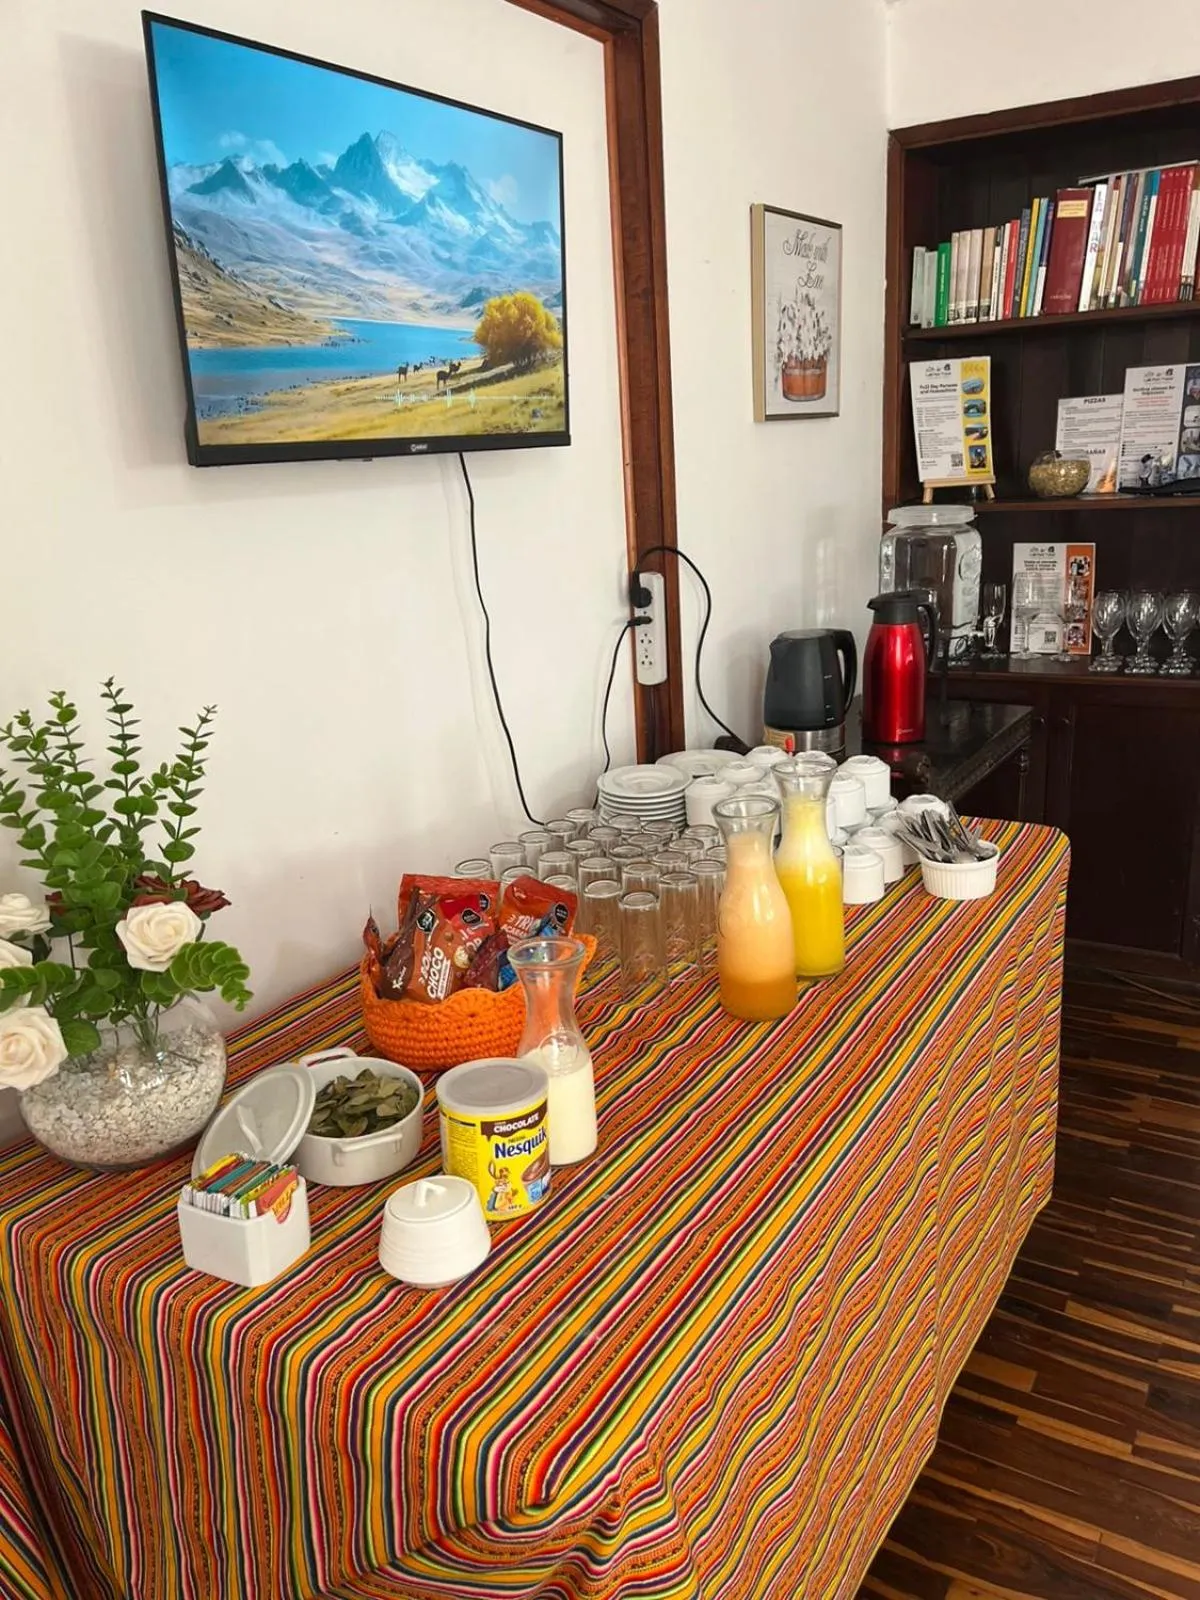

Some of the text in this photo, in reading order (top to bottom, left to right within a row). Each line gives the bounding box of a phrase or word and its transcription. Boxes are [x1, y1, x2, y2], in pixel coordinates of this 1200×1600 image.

[782, 229, 815, 258] Made
[427, 947, 445, 999] CHOCO
[493, 1112, 540, 1133] CHOCOLATE
[494, 1126, 547, 1159] Nesquik
